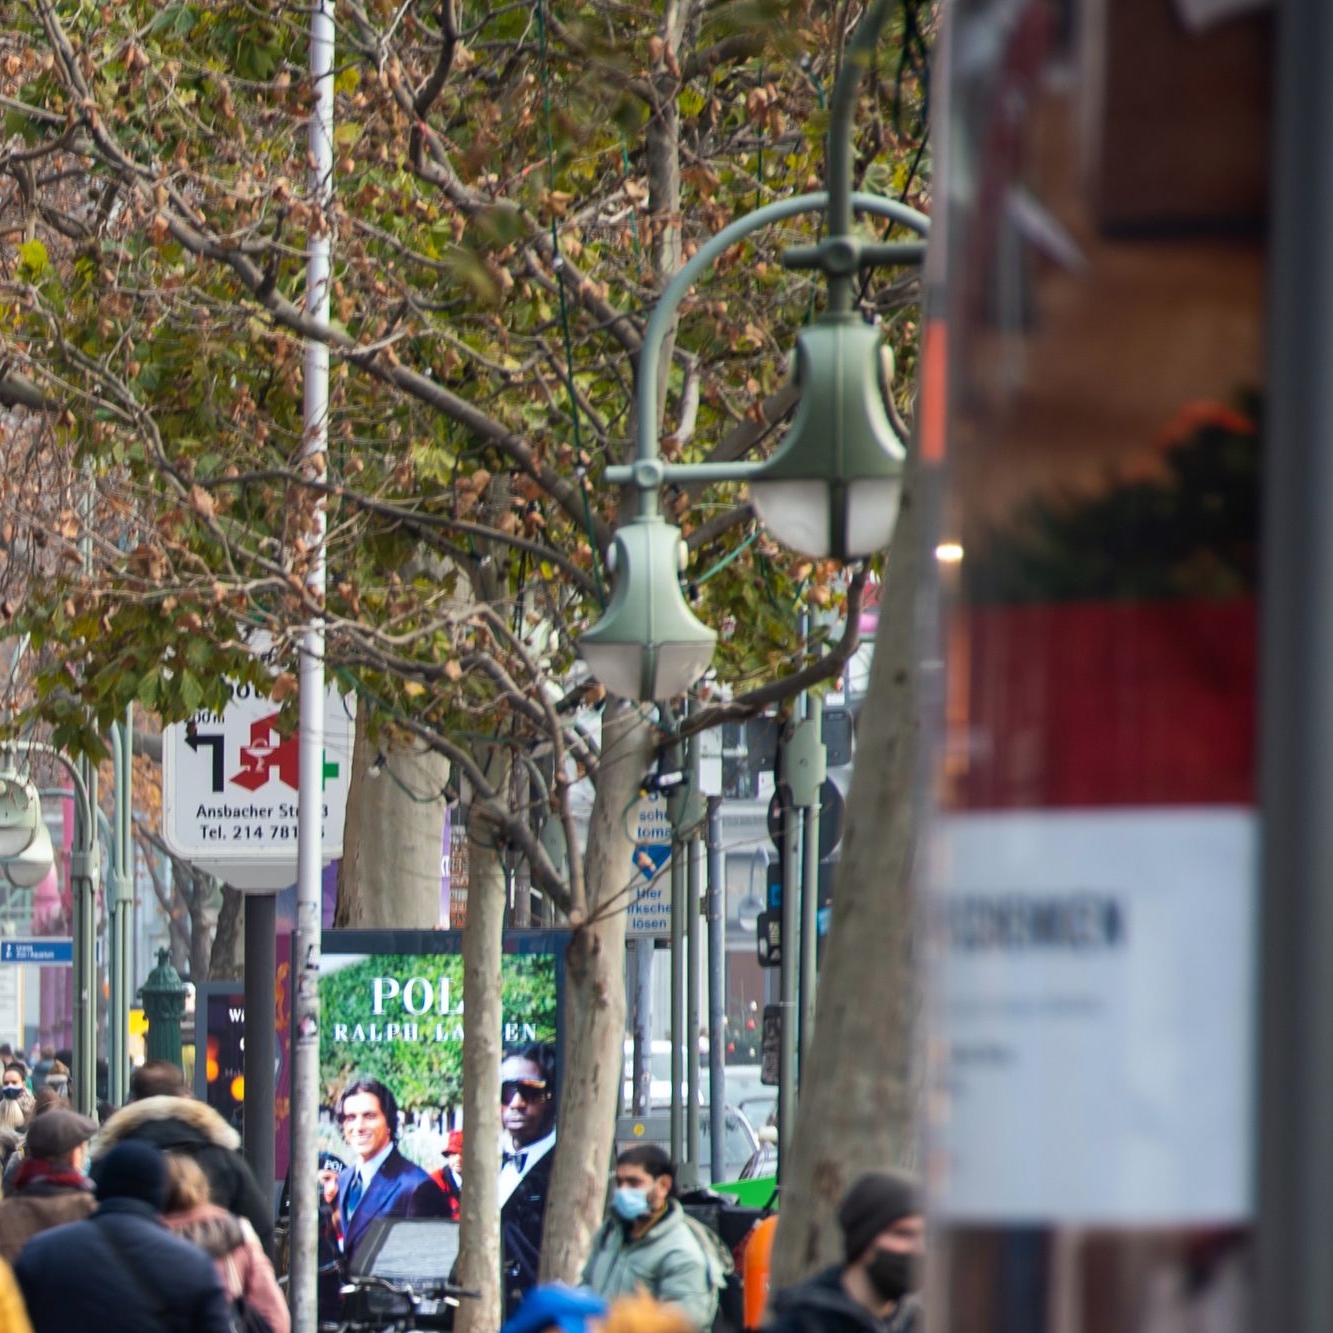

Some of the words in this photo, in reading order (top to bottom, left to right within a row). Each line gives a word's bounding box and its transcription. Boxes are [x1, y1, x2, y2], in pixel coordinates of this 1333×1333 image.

[196, 803, 273, 819] Ansbacher
[200, 825, 226, 840] Tel.
[233, 826, 262, 840] 214
[632, 917, 667, 930] lösen
[372, 976, 464, 1016] POL
[335, 1023, 418, 1041] RALPH
[435, 1023, 537, 1041] LAEN
